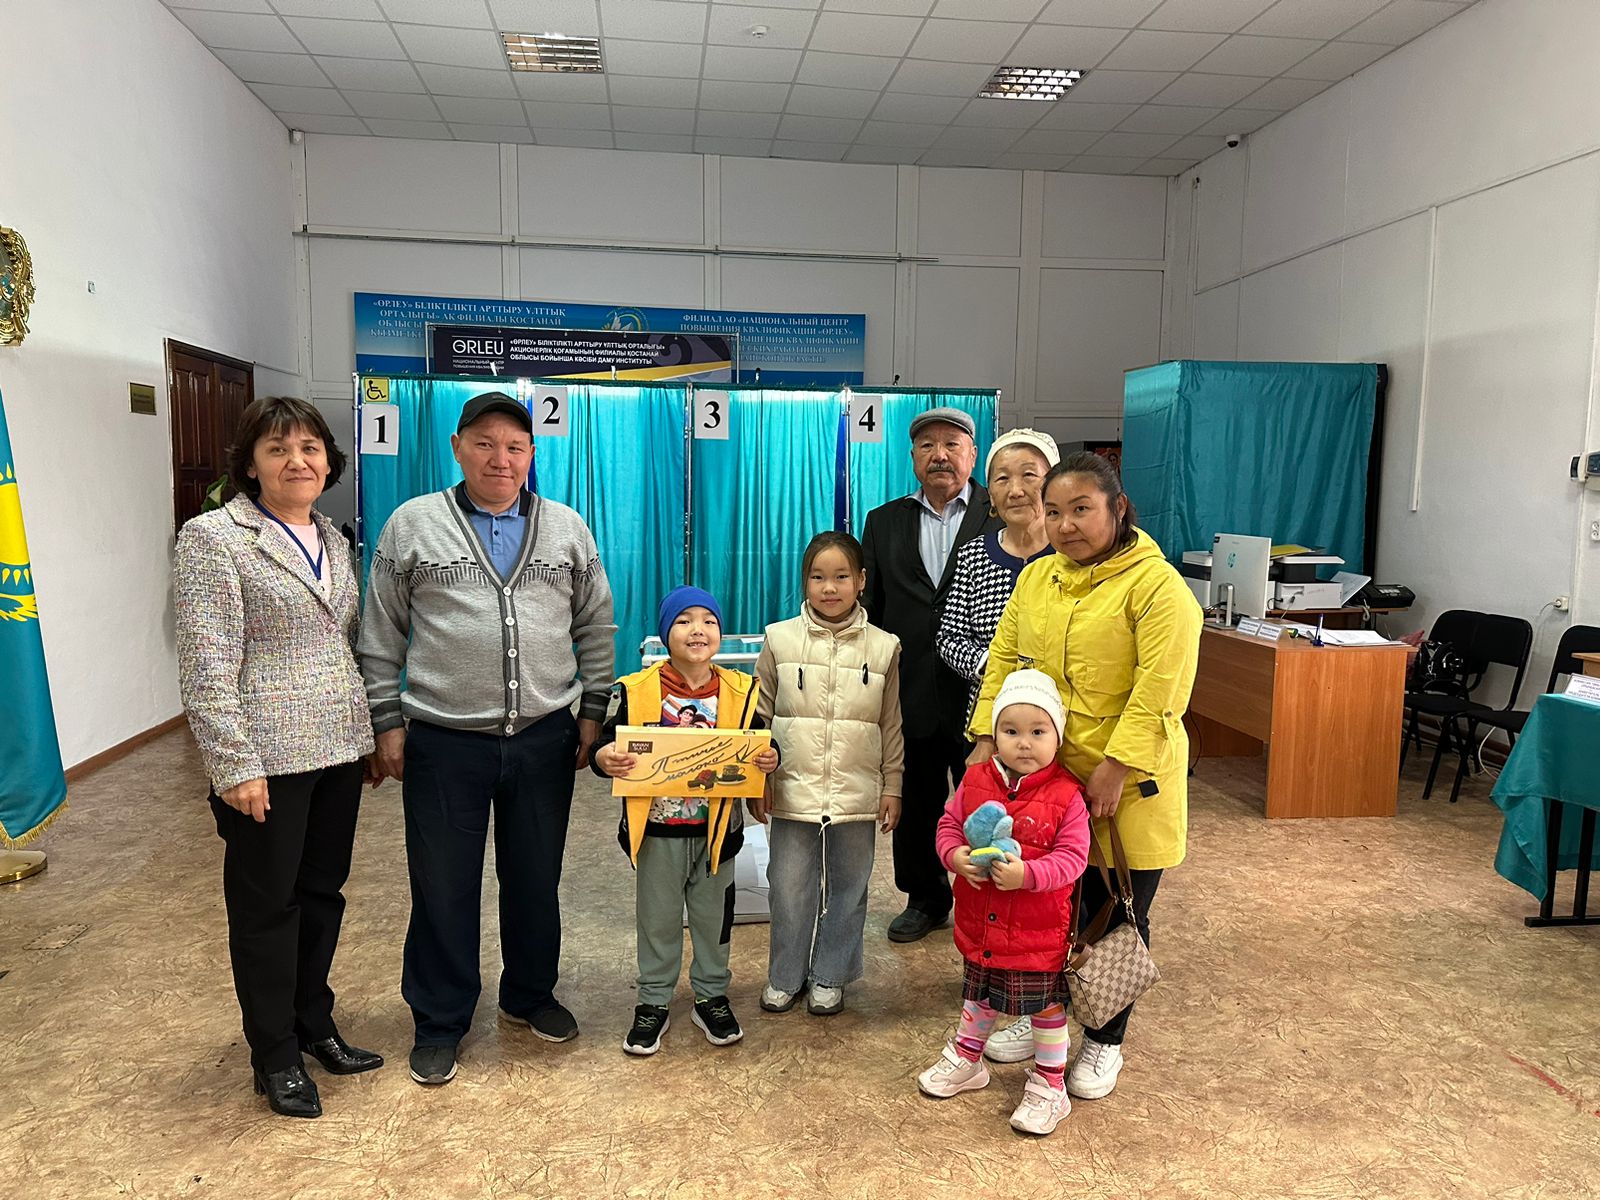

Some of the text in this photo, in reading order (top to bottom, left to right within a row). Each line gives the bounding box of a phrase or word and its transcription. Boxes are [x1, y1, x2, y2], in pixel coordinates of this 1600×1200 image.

[479, 305, 523, 314] АРТТЫРУ
[457, 313, 507, 323] ФИЛИАЛЫ
[683, 314, 722, 323] ФИЛИАЛ
[820, 318, 849, 327] ЦЕНТР
[680, 324, 740, 333] ПОВЫШЕНИЯ
[743, 326, 816, 336] КВАЛИФИКАЦИИ
[510, 353, 539, 361] ОБЛЫСЫ
[540, 354, 573, 362] БОЙЫНША
[615, 357, 653, 365] ИНСТИТУТЫ
[542, 396, 561, 425] 2
[703, 400, 721, 429] 3
[858, 404, 876, 432] 4
[373, 414, 389, 444] 1
